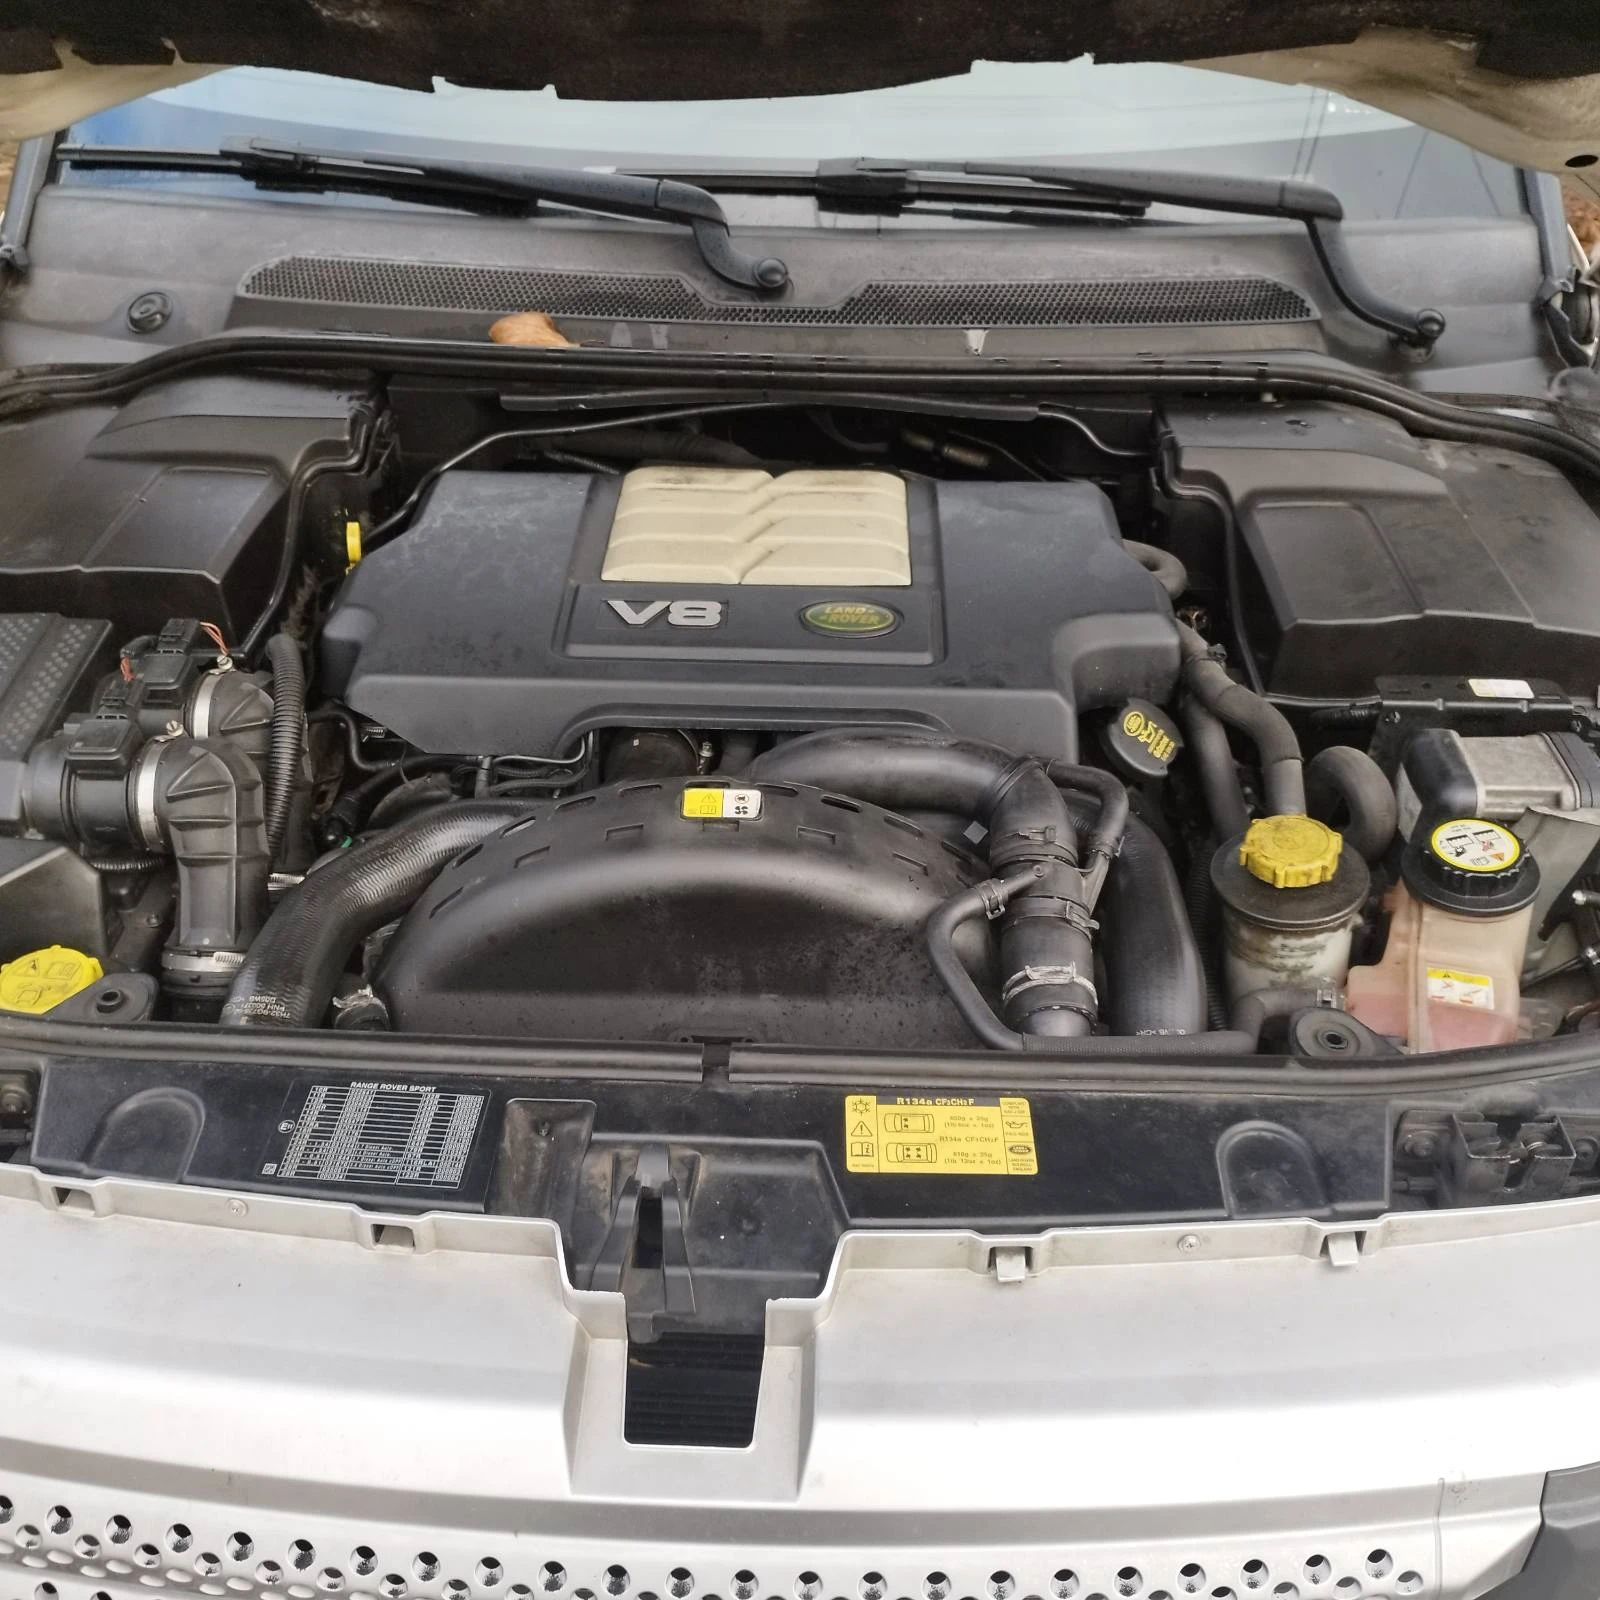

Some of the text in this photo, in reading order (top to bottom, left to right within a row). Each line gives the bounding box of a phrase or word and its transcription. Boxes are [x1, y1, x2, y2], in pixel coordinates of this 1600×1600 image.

[607, 600, 721, 626] V8
[824, 606, 866, 614] LAND
[828, 613, 880, 625] ROVER
[350, 1081, 379, 1090] RANGE
[380, 1083, 408, 1092] ROVER
[409, 1085, 437, 1093] SPORT
[896, 1097, 933, 1105] R134a
